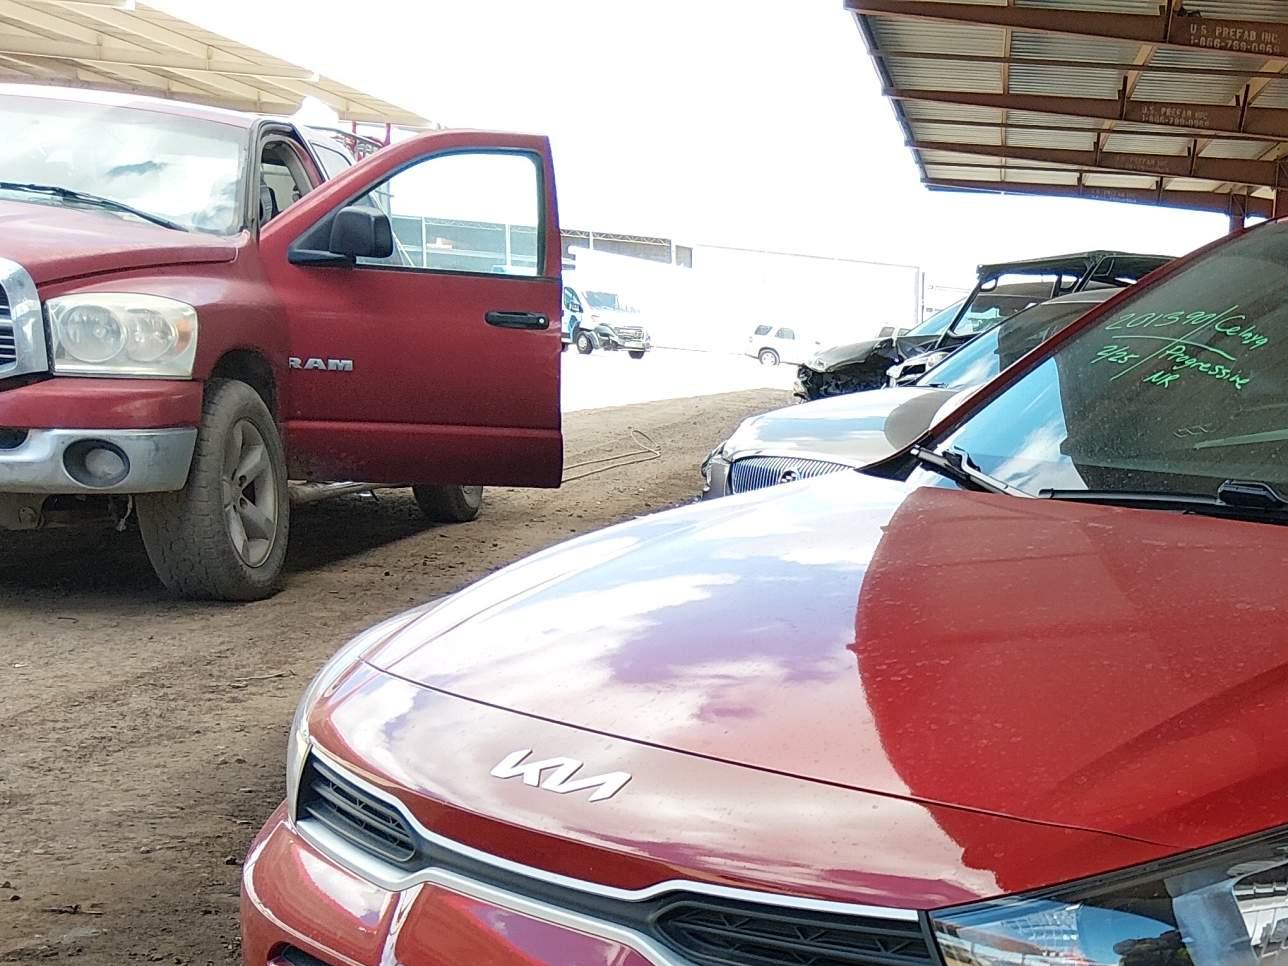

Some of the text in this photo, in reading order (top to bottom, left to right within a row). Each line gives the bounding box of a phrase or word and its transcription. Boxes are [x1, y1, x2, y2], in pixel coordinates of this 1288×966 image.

[1215, 26, 1257, 41] PREFAB
[288, 356, 353, 372] RAM
[1158, 345, 1250, 390] Progressive
[490, 748, 633, 803] KIA
